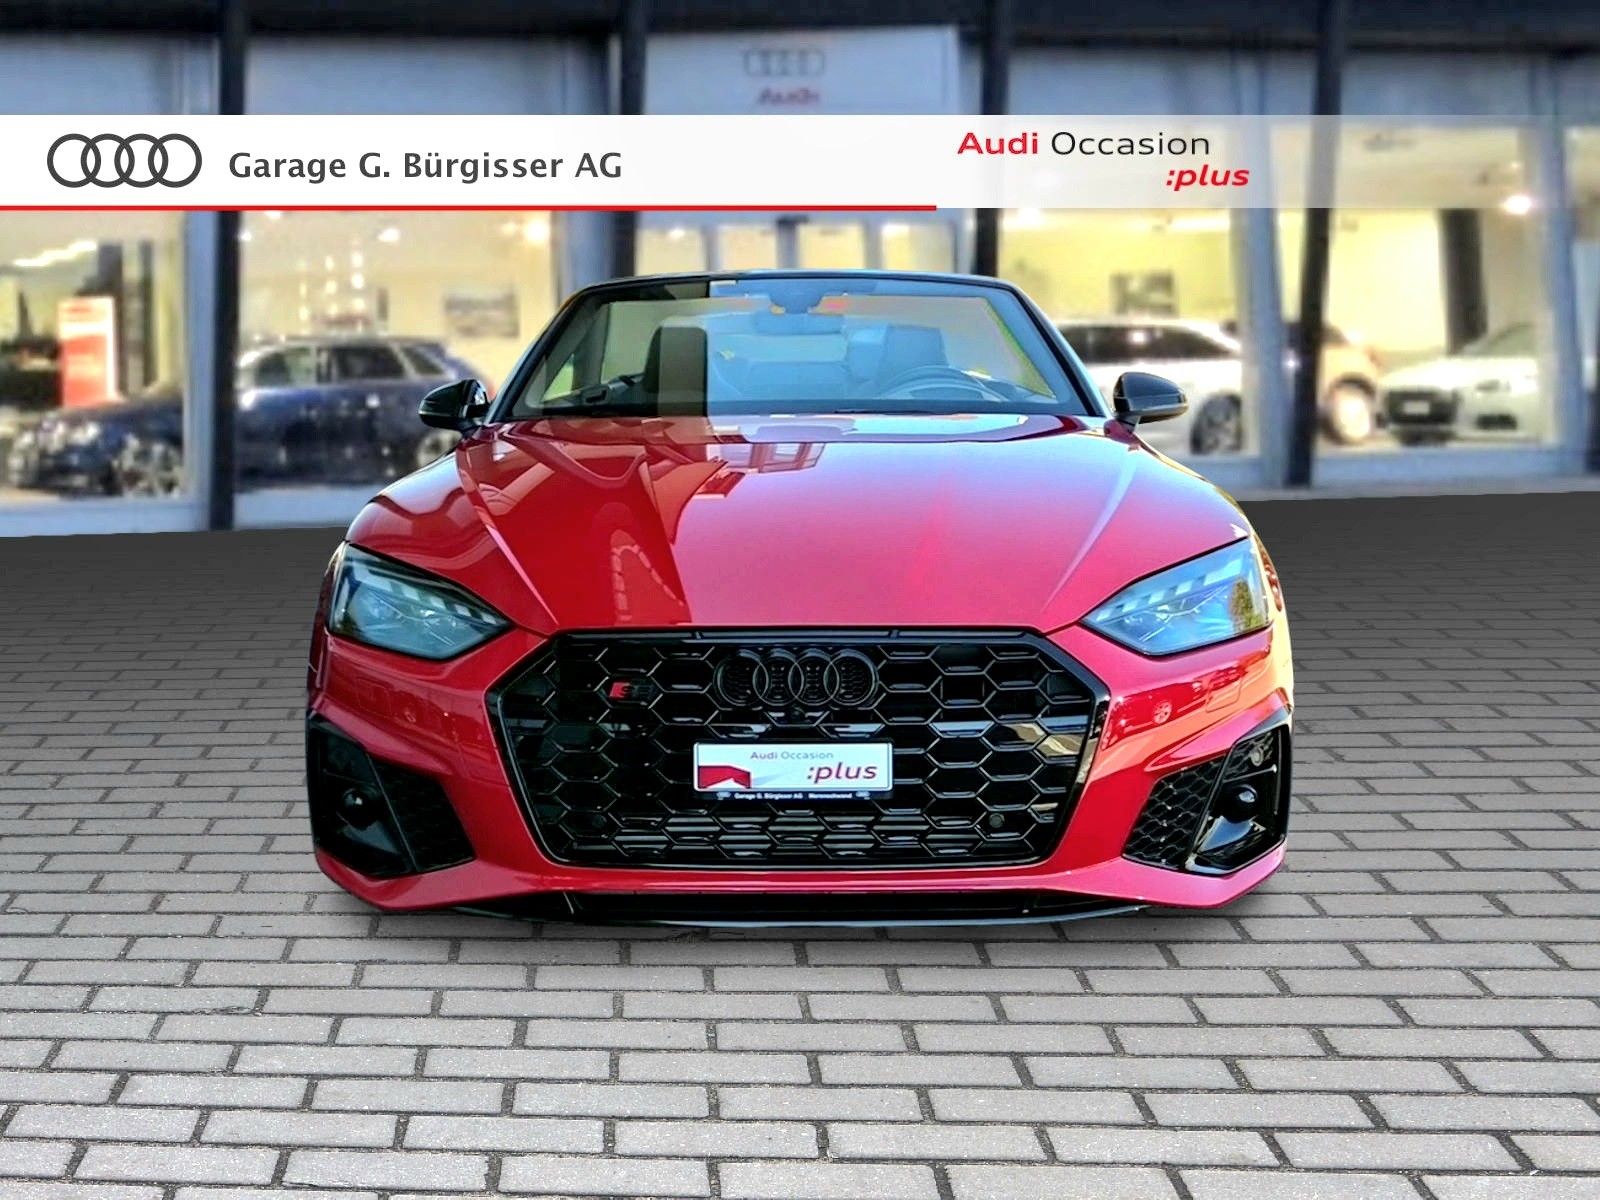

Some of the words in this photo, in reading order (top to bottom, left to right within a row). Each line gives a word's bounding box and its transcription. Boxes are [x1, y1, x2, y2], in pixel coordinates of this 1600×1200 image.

[750, 750, 778, 760] Audi
[780, 750, 834, 760] Occasion
[807, 761, 878, 785] :plus
